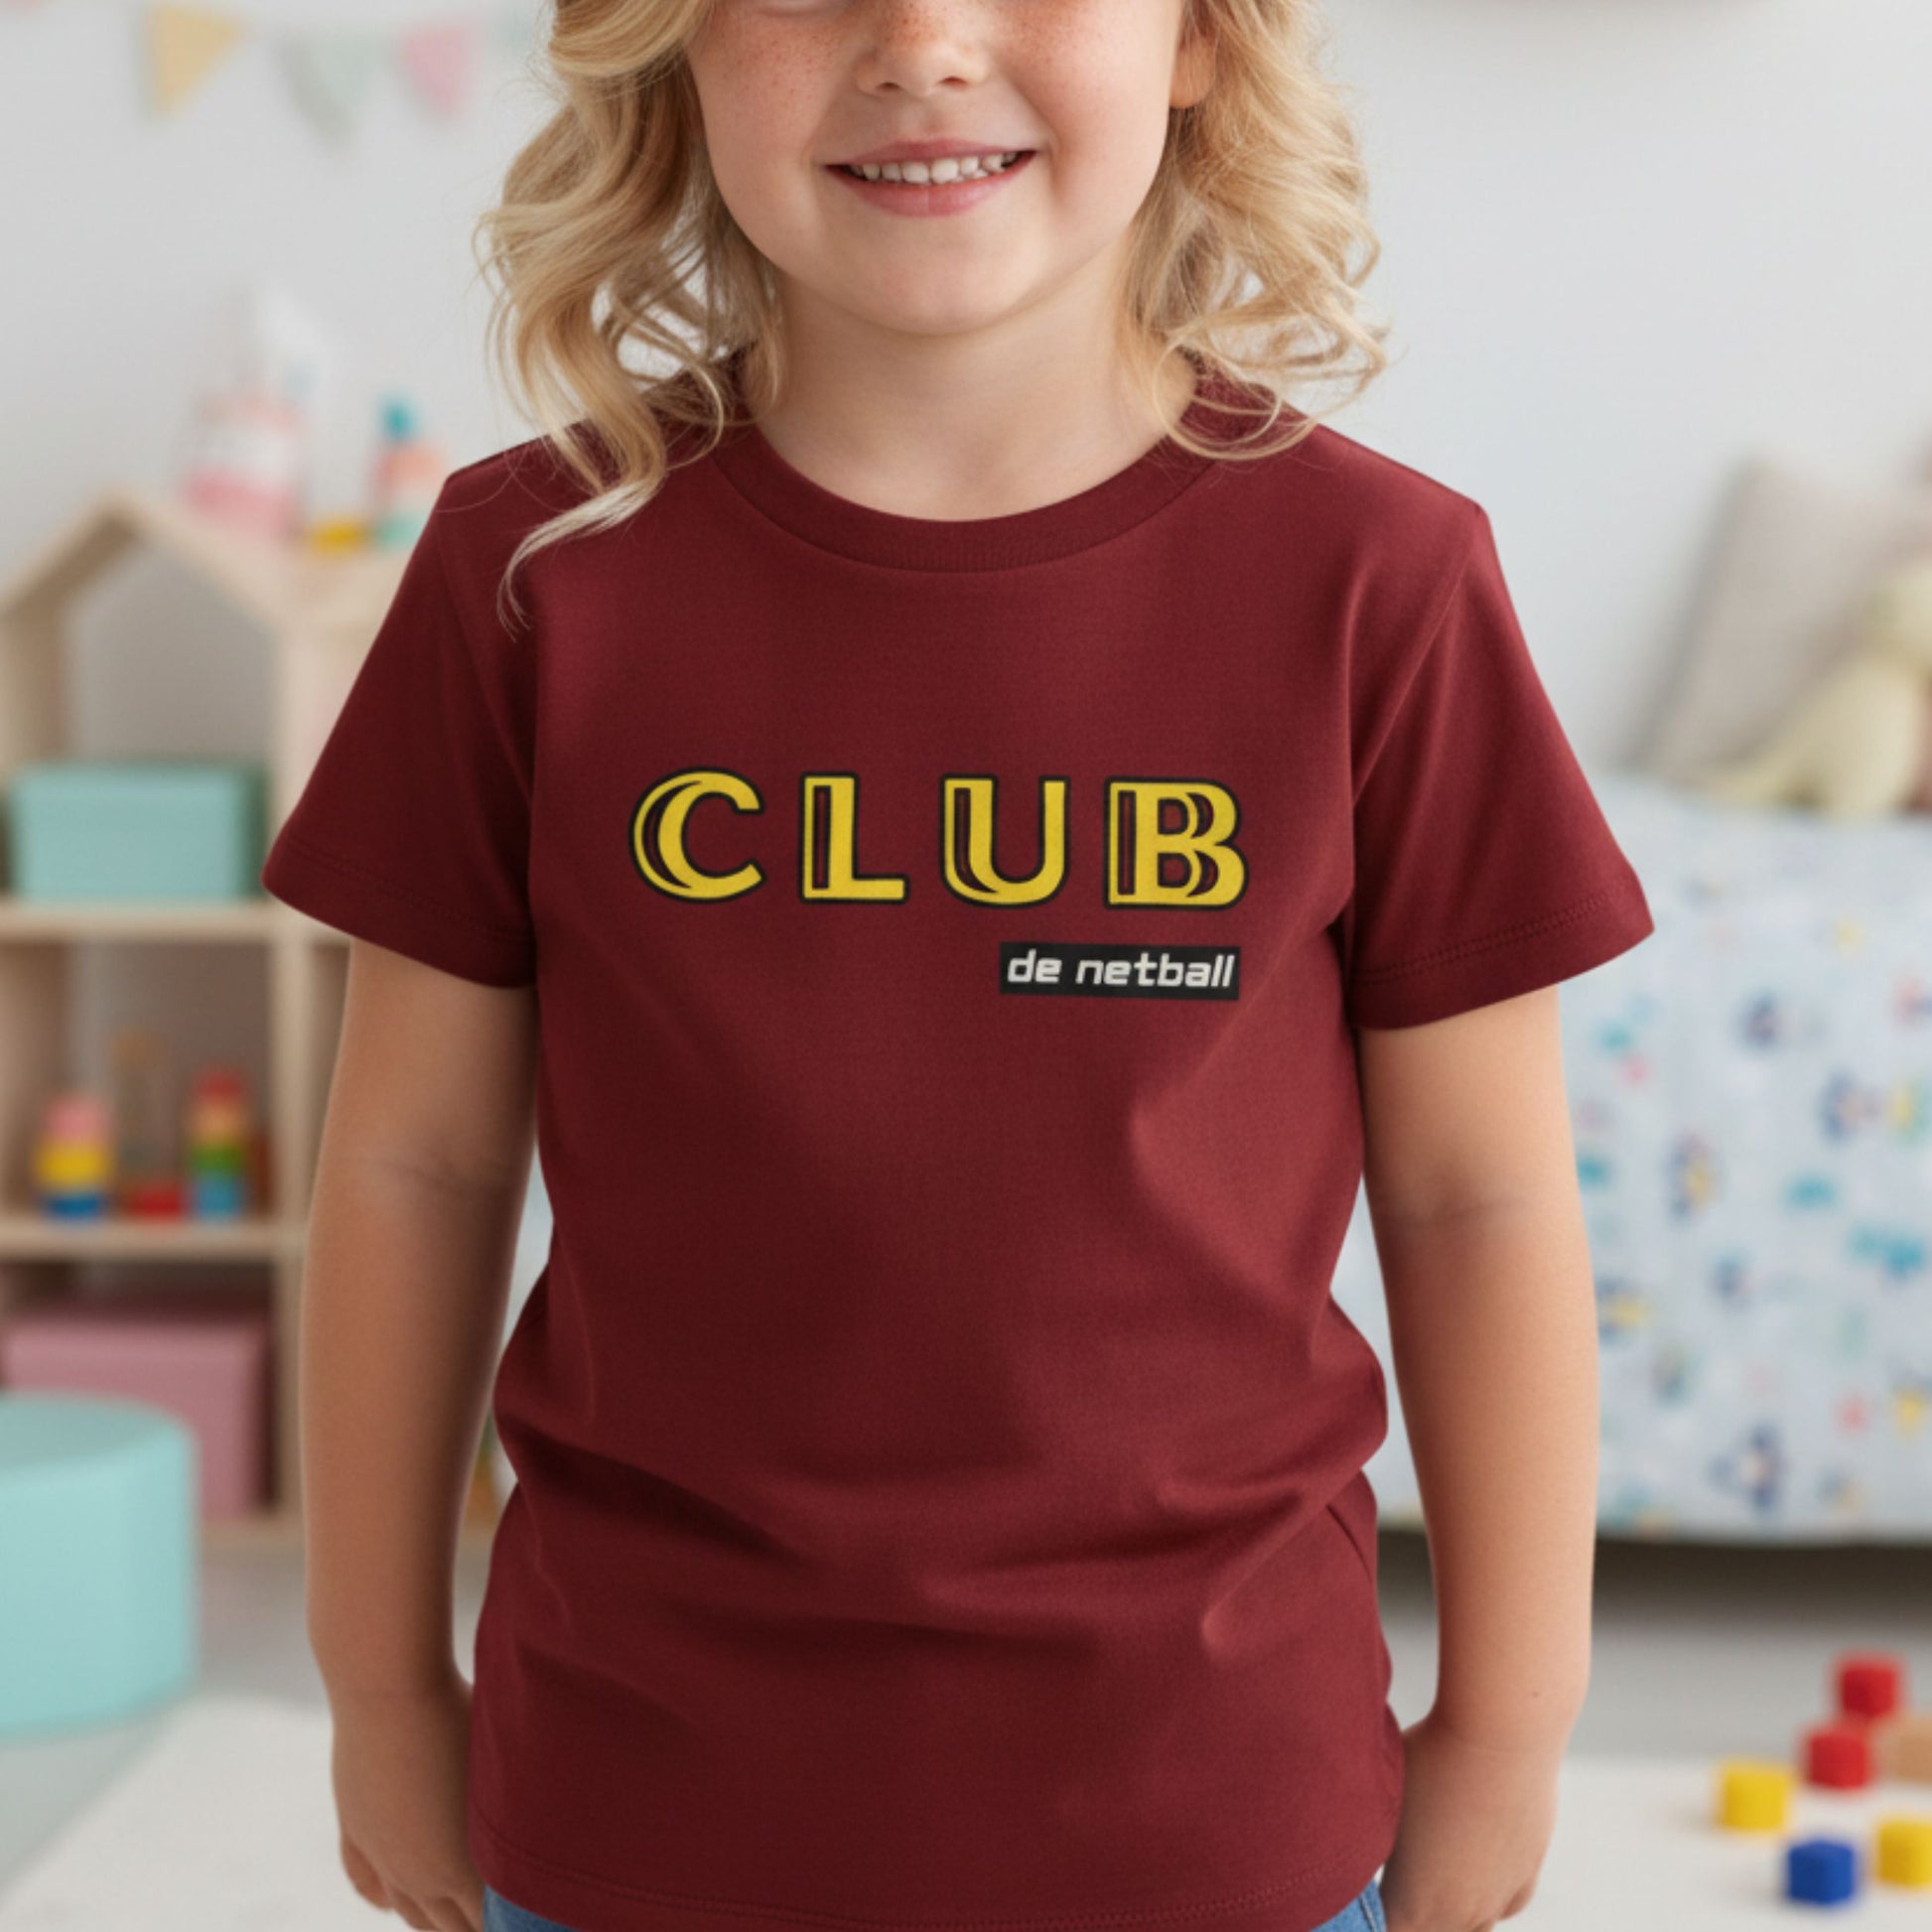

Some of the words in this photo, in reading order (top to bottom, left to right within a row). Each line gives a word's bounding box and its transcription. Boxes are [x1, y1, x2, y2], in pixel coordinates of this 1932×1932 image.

[630, 768, 1247, 908] CLUB
[1007, 948, 1062, 983] de
[1075, 951, 1236, 988] netball
